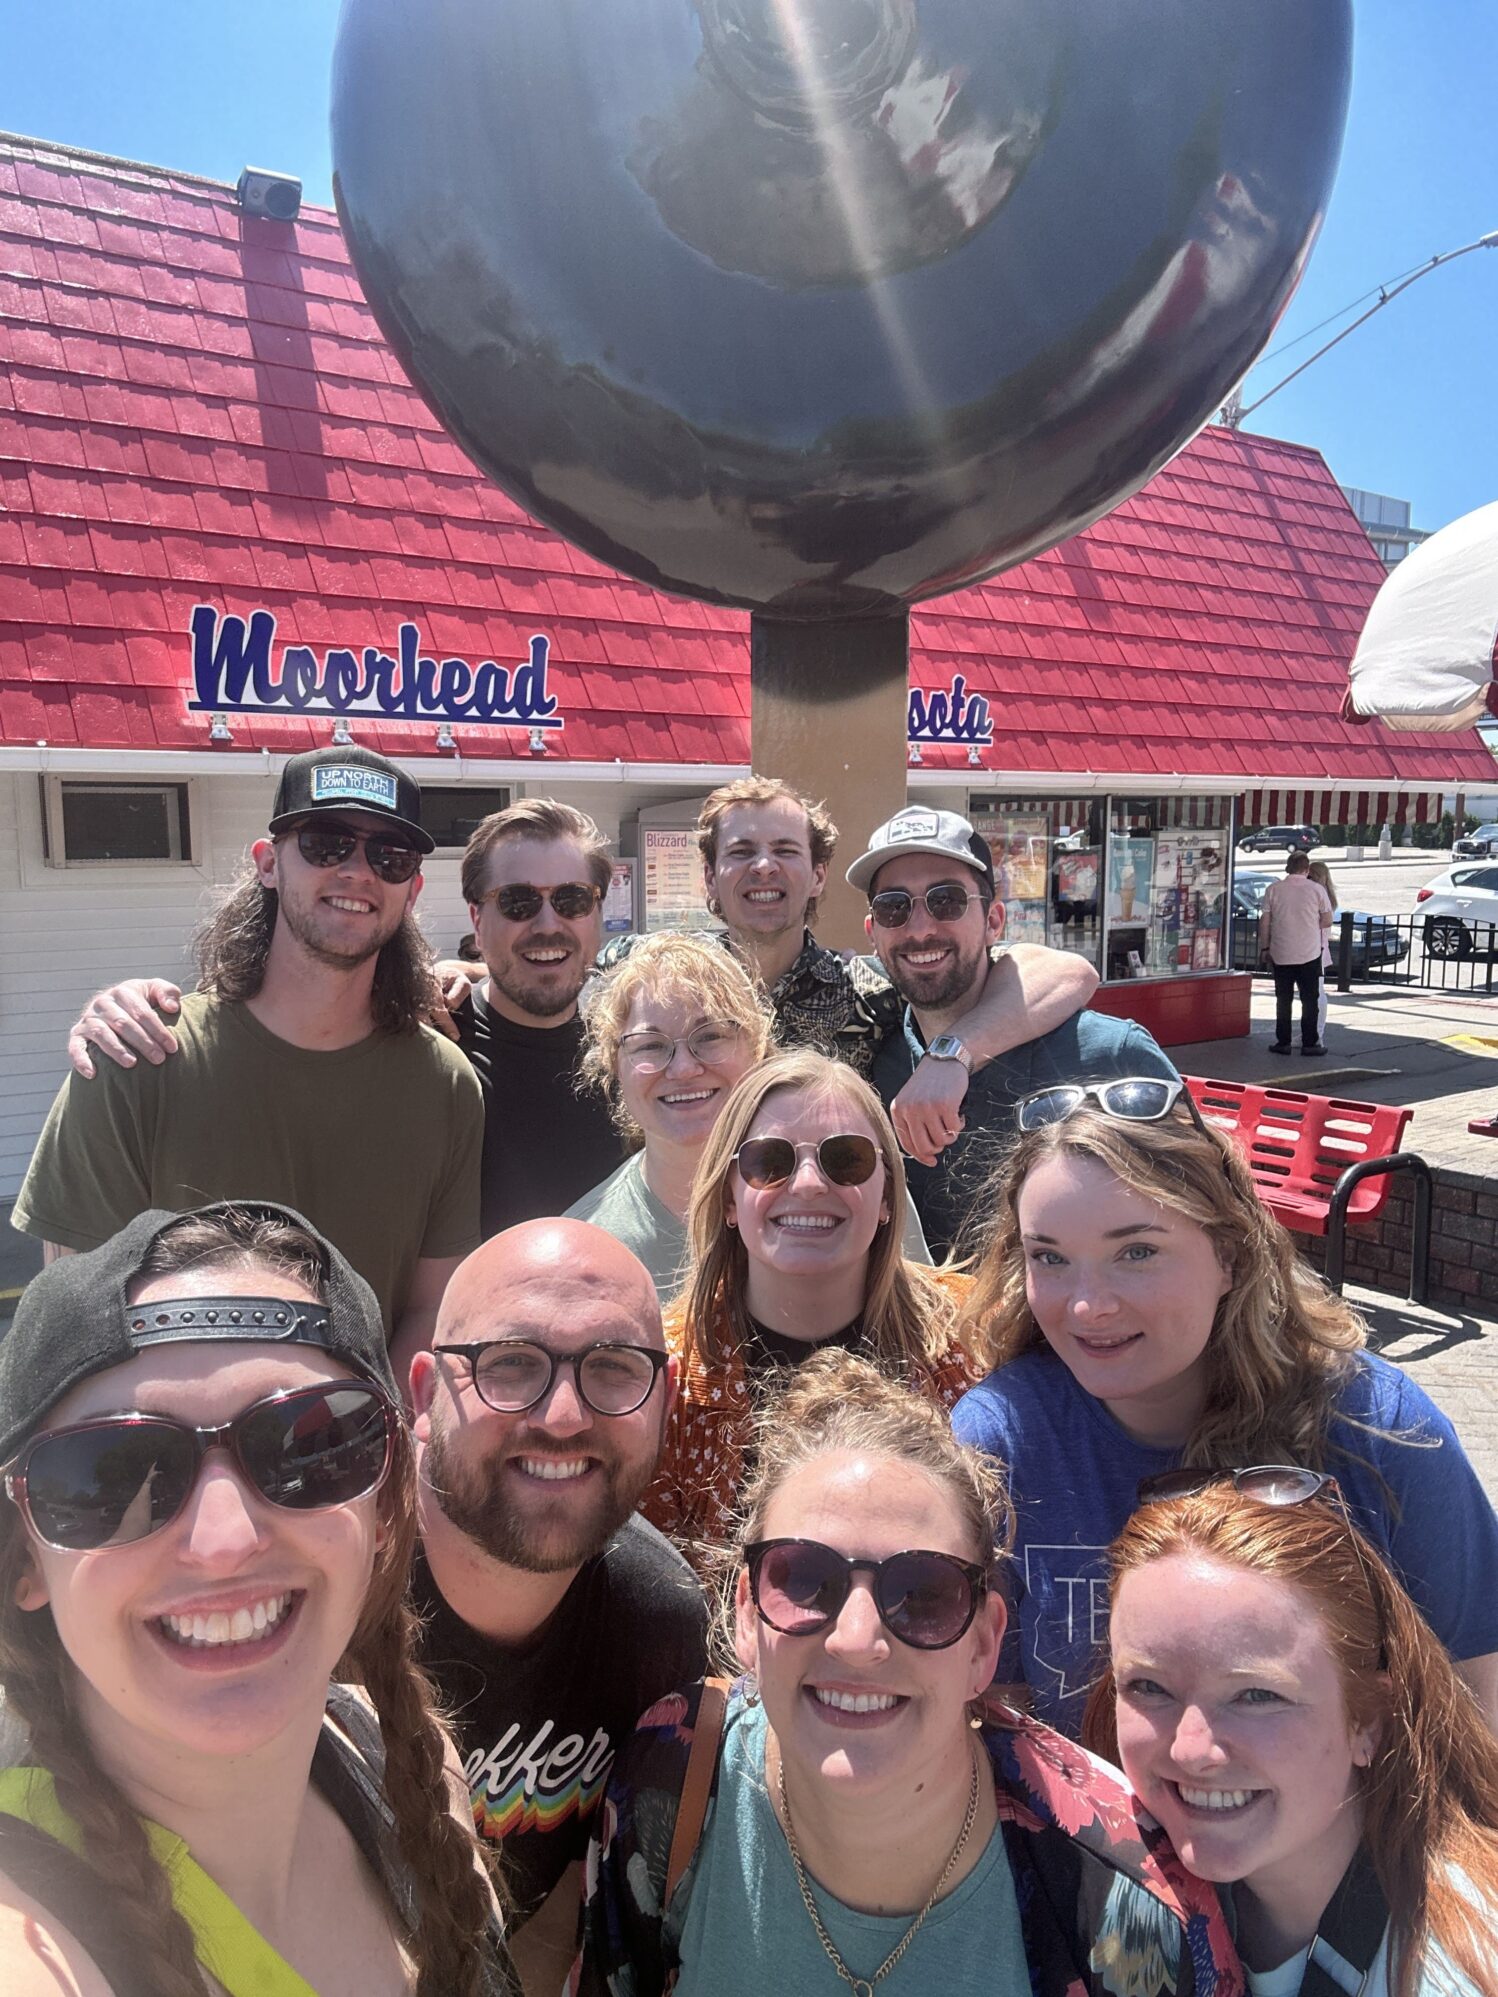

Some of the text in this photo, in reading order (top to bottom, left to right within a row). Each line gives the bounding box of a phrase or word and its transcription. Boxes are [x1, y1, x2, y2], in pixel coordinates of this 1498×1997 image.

[190, 604, 993, 739] Moorhead sota
[321, 770, 389, 787] UP NORTH
[321, 778, 389, 796] DOWN TO EARTH
[646, 832, 687, 848] Blizzard
[1054, 1577, 1111, 1644] TE
[463, 1719, 615, 1796] ekker
